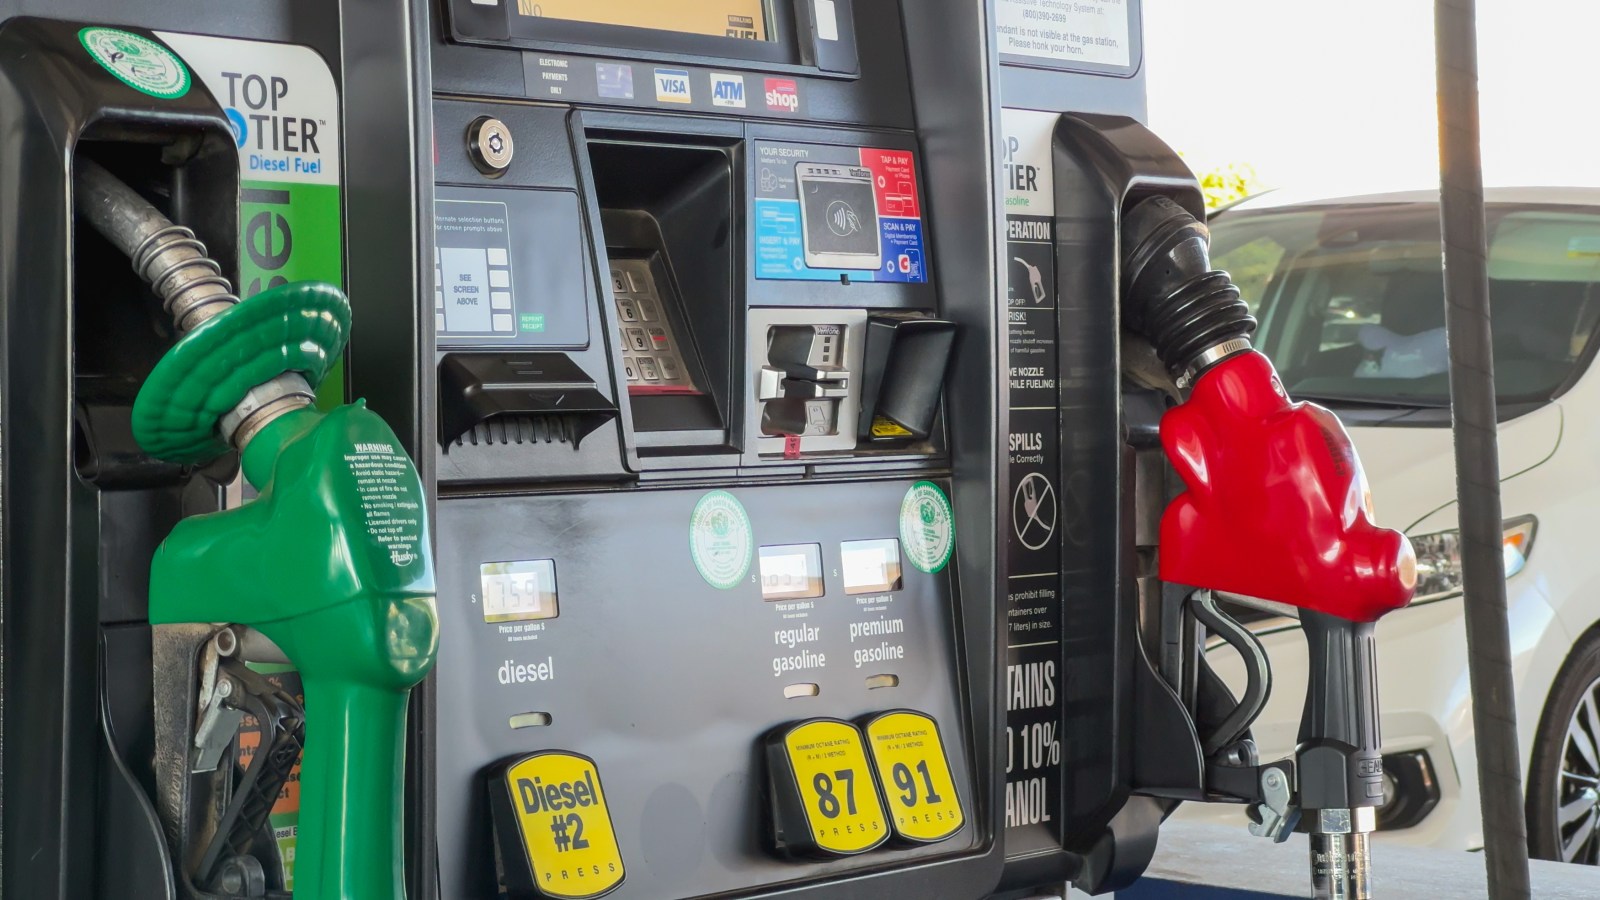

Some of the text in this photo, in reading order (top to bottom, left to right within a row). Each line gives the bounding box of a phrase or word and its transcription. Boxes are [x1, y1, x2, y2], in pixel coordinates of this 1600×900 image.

[1039, 1, 1072, 12] Technology
[1074, 3, 1096, 14] System
[1019, 27, 1026, 37] is
[1027, 29, 1038, 38] not
[1040, 30, 1061, 41] visible
[1062, 33, 1069, 42] at
[1070, 34, 1080, 43] the
[1082, 36, 1094, 46] gas
[1008, 37, 1084, 55] Please honk your horn.
[540, 58, 568, 68] ELECTRONIC
[542, 71, 568, 81] PAYMENTS
[221, 72, 288, 111] TOP
[550, 86, 563, 95] ONLY
[659, 79, 686, 94] VISA
[714, 80, 742, 101] ATM
[765, 89, 798, 113] shop
[249, 114, 320, 154] TIER
[760, 146, 809, 158] YOUR SECURITY
[249, 154, 321, 174] Diesel Fuel
[880, 155, 891, 164] TAP
[898, 156, 908, 166] PAY
[883, 223, 899, 231] SCAN
[459, 274, 472, 282] SEE
[616, 280, 623, 289] 3
[453, 286, 479, 294] SCREEN
[626, 309, 633, 319] 6
[1009, 311, 1026, 321] RISK!
[636, 337, 643, 348] 9
[626, 366, 633, 377] 0
[1019, 367, 1044, 376] NOZZLE
[1026, 379, 1055, 389] FUELING!
[354, 443, 394, 453] WARNING
[1009, 432, 1043, 451] SPILLS
[1016, 454, 1044, 464] Correctly
[390, 550, 414, 564] Husky
[856, 597, 867, 605] Price
[1014, 590, 1038, 602] prohibit
[1039, 589, 1055, 599] filling
[775, 604, 787, 612] Price
[796, 602, 810, 610] gallon
[1034, 607, 1047, 615] over
[499, 625, 513, 634] Price
[514, 626, 523, 634] per
[524, 624, 541, 632] gallon
[850, 615, 903, 642] premium
[1013, 621, 1031, 631] liters)
[1032, 621, 1037, 629] in
[774, 623, 820, 648] regular
[854, 642, 904, 668] gasoline
[773, 650, 826, 677] gasoline
[498, 656, 554, 685] diesel
[796, 739, 850, 751] MINIMUM OCTANE RATING
[1020, 720, 1060, 771] 10%
[892, 759, 941, 808] 91
[517, 770, 599, 814] Diesel
[812, 768, 857, 819] 87
[901, 810, 955, 826] PRESS
[550, 813, 590, 853] #2
[820, 821, 878, 838] PRESS
[546, 863, 615, 882] PRESS
